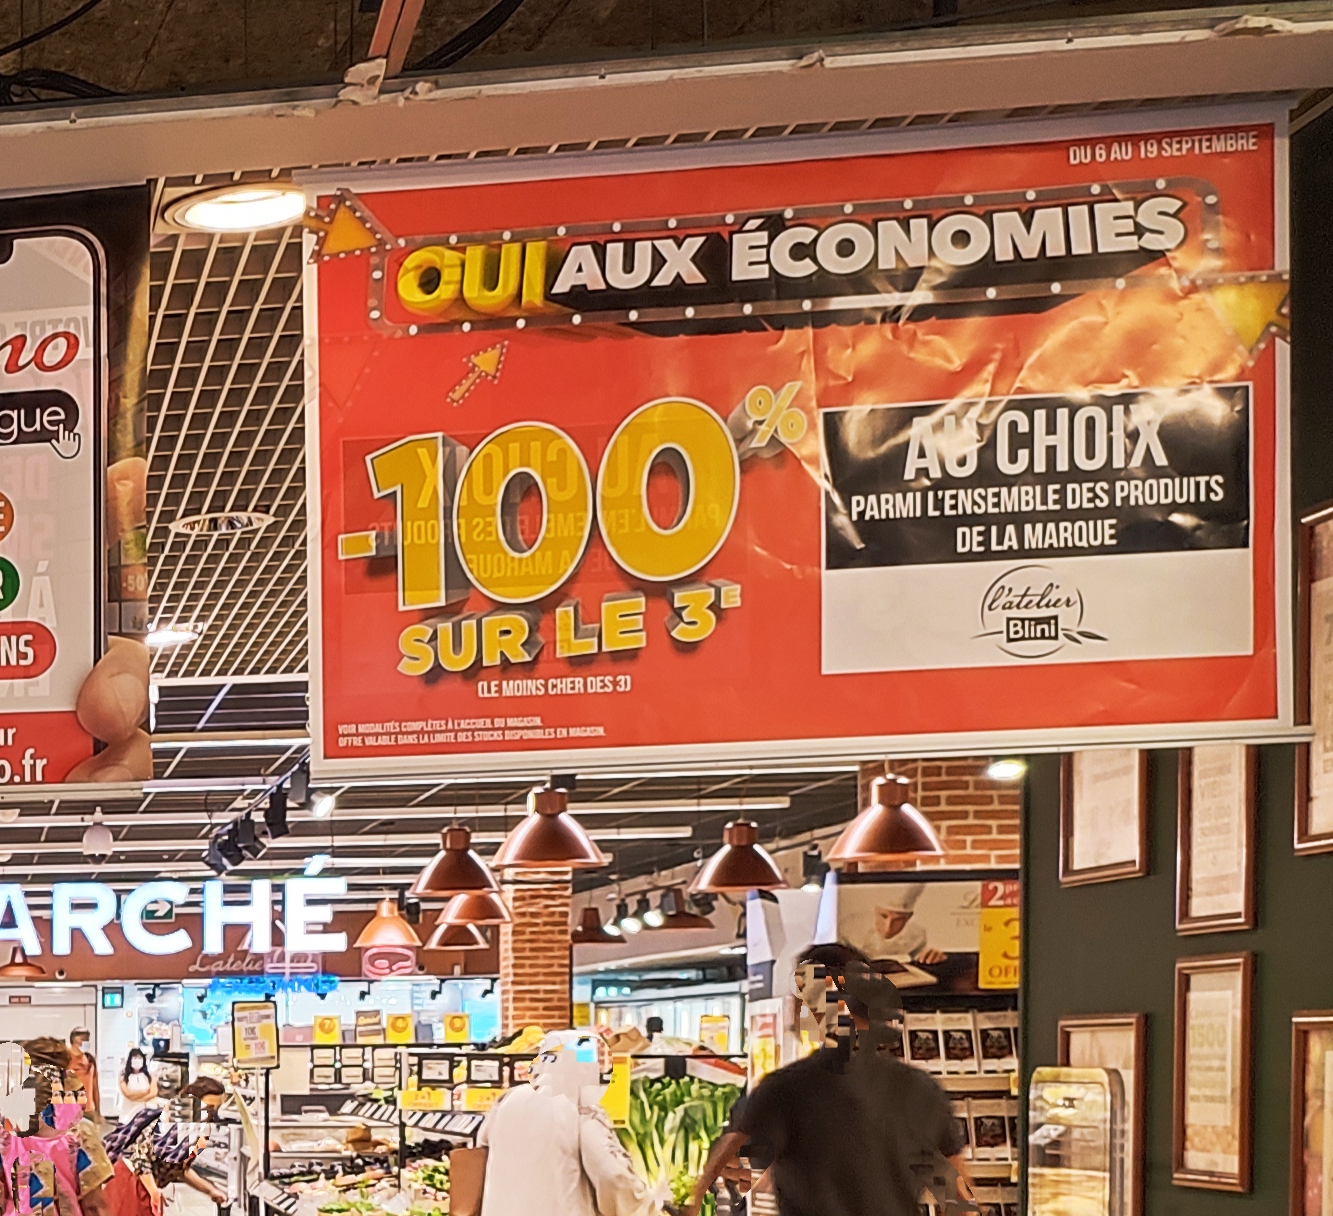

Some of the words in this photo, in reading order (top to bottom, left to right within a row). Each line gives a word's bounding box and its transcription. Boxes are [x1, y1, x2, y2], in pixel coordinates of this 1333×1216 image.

[1069, 145, 1091, 164] DU
[1095, 144, 1106, 163] 6
[1110, 143, 1132, 161] AU
[1138, 140, 1158, 159] 19
[1161, 131, 1258, 157] SEPTEMBRE
[397, 239, 548, 312] OUI
[550, 235, 708, 295] AUX
[731, 196, 1186, 281] ÉCONOMIES
[903, 412, 978, 481] AU
[996, 403, 1169, 476] CHOIX
[851, 493, 922, 521] PARMI
[927, 484, 1062, 517] L'ENSEMBLE
[1067, 482, 1110, 509] DES
[1115, 475, 1225, 507] PRODUITS
[956, 526, 985, 553] DE
[991, 525, 1019, 551] LA
[1023, 519, 1118, 550] MARQUE
[397, 614, 533, 676] SUR
[556, 596, 647, 659] LE
[1008, 618, 1057, 641] Blini
[502, 679, 545, 697] MOINS
[548, 677, 583, 695] CHER
[587, 676, 614, 693] DES
[338, 723, 356, 735] VOIR
